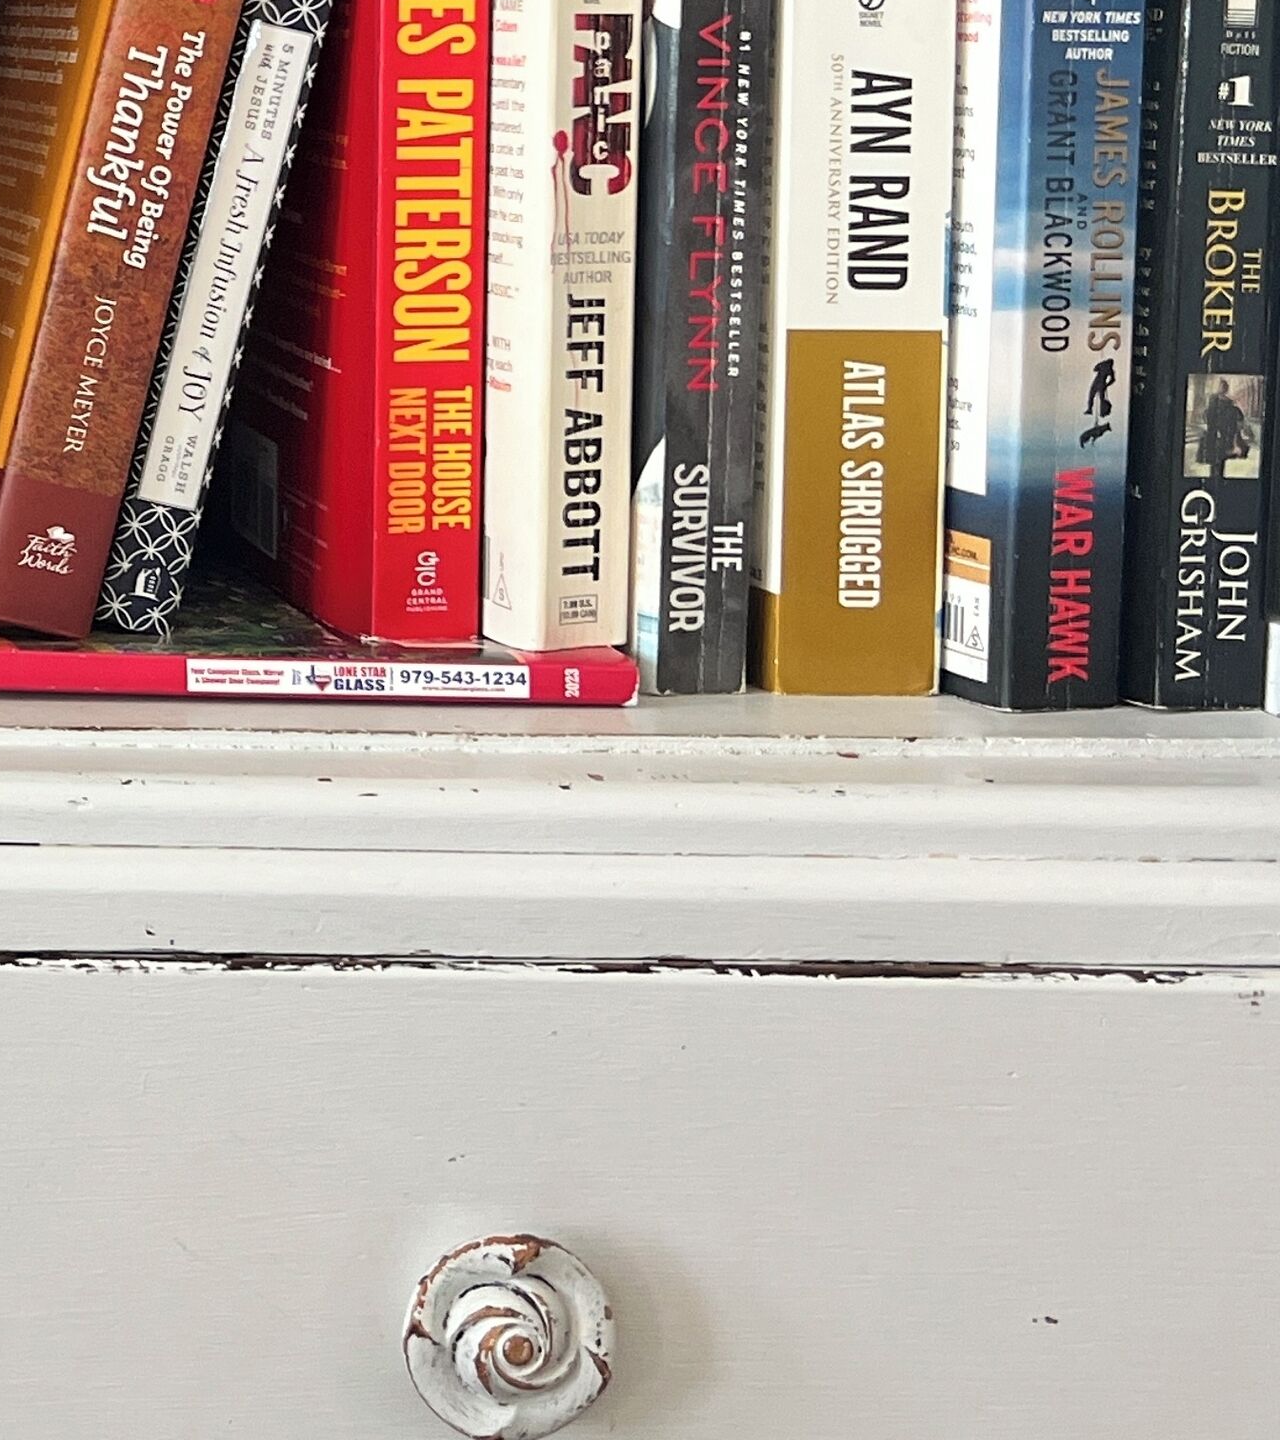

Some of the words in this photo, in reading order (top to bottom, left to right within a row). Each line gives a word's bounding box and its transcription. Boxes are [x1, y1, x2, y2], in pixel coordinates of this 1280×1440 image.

[281, 42, 295, 54] 5
[1042, 11, 1068, 24] NEW
[1069, 11, 1102, 24] YORK
[1104, 11, 1142, 25] TIMES
[1051, 29, 1130, 43] BESTSELLING
[173, 30, 206, 78] The
[737, 63, 751, 106] NEW
[1065, 47, 1114, 61] AUTHOR
[155, 84, 194, 159] Power
[245, 75, 270, 131] JESUS
[264, 57, 291, 142] MINUTES
[692, 14, 733, 196] VINCE
[849, 68, 914, 155] AYN
[1046, 69, 1078, 166] GRANT
[1208, 118, 1236, 132] NEW
[1238, 118, 1273, 133] YORK
[1217, 74, 1255, 107] #1
[85, 44, 169, 239] Thankful
[241, 144, 264, 169] A
[734, 117, 749, 168] YORK
[827, 96, 844, 222] ANNIVERSARY
[1092, 66, 1131, 189] JAMES
[1197, 151, 1278, 166] BESTSELLER
[1216, 135, 1256, 148] TIMES
[147, 164, 173, 200] Of
[226, 167, 260, 235] Fresh
[731, 179, 747, 241] TIMES
[1075, 193, 1088, 231] AND
[123, 199, 166, 270] Being
[393, 78, 475, 363] PATTERSON
[846, 174, 911, 292] RAND
[200, 238, 244, 341] Infusion
[825, 227, 841, 306] EDITION
[1040, 175, 1076, 353] BLACKWOOD
[1087, 197, 1126, 352] ROLLINS
[1200, 186, 1246, 358] BROKER
[1241, 248, 1263, 294] THE
[80, 294, 118, 370] JOYCE
[686, 215, 727, 392] FLYNN
[727, 248, 743, 378] BESTSELLER
[565, 293, 606, 393] JEFF
[62, 373, 99, 455] MEYER
[177, 366, 214, 424] JOY
[387, 386, 428, 456] NEXT
[432, 384, 473, 435] THE
[841, 360, 886, 451] ATLAS
[155, 434, 176, 484] GRAGG
[173, 434, 199, 495] WALSH
[431, 441, 473, 531] HOUSE
[387, 461, 428, 535] DOOR
[560, 408, 604, 582] ABBOTT
[1050, 466, 1097, 558] WAR
[17, 549, 74, 576] Words
[26, 532, 77, 560] Faith
[668, 462, 710, 634] SURVIVOR
[710, 521, 745, 573] THE
[838, 460, 885, 609] SHRUGGED
[1174, 489, 1215, 682] GRISHAM
[1211, 528, 1259, 642] JOHN
[1046, 568, 1093, 685] HAWK
[333, 665, 359, 678] LONE
[361, 665, 387, 678] STAR
[333, 677, 386, 692] GLASS
[399, 669, 527, 687] 979-543-1234
[565, 667, 581, 699] 2023
